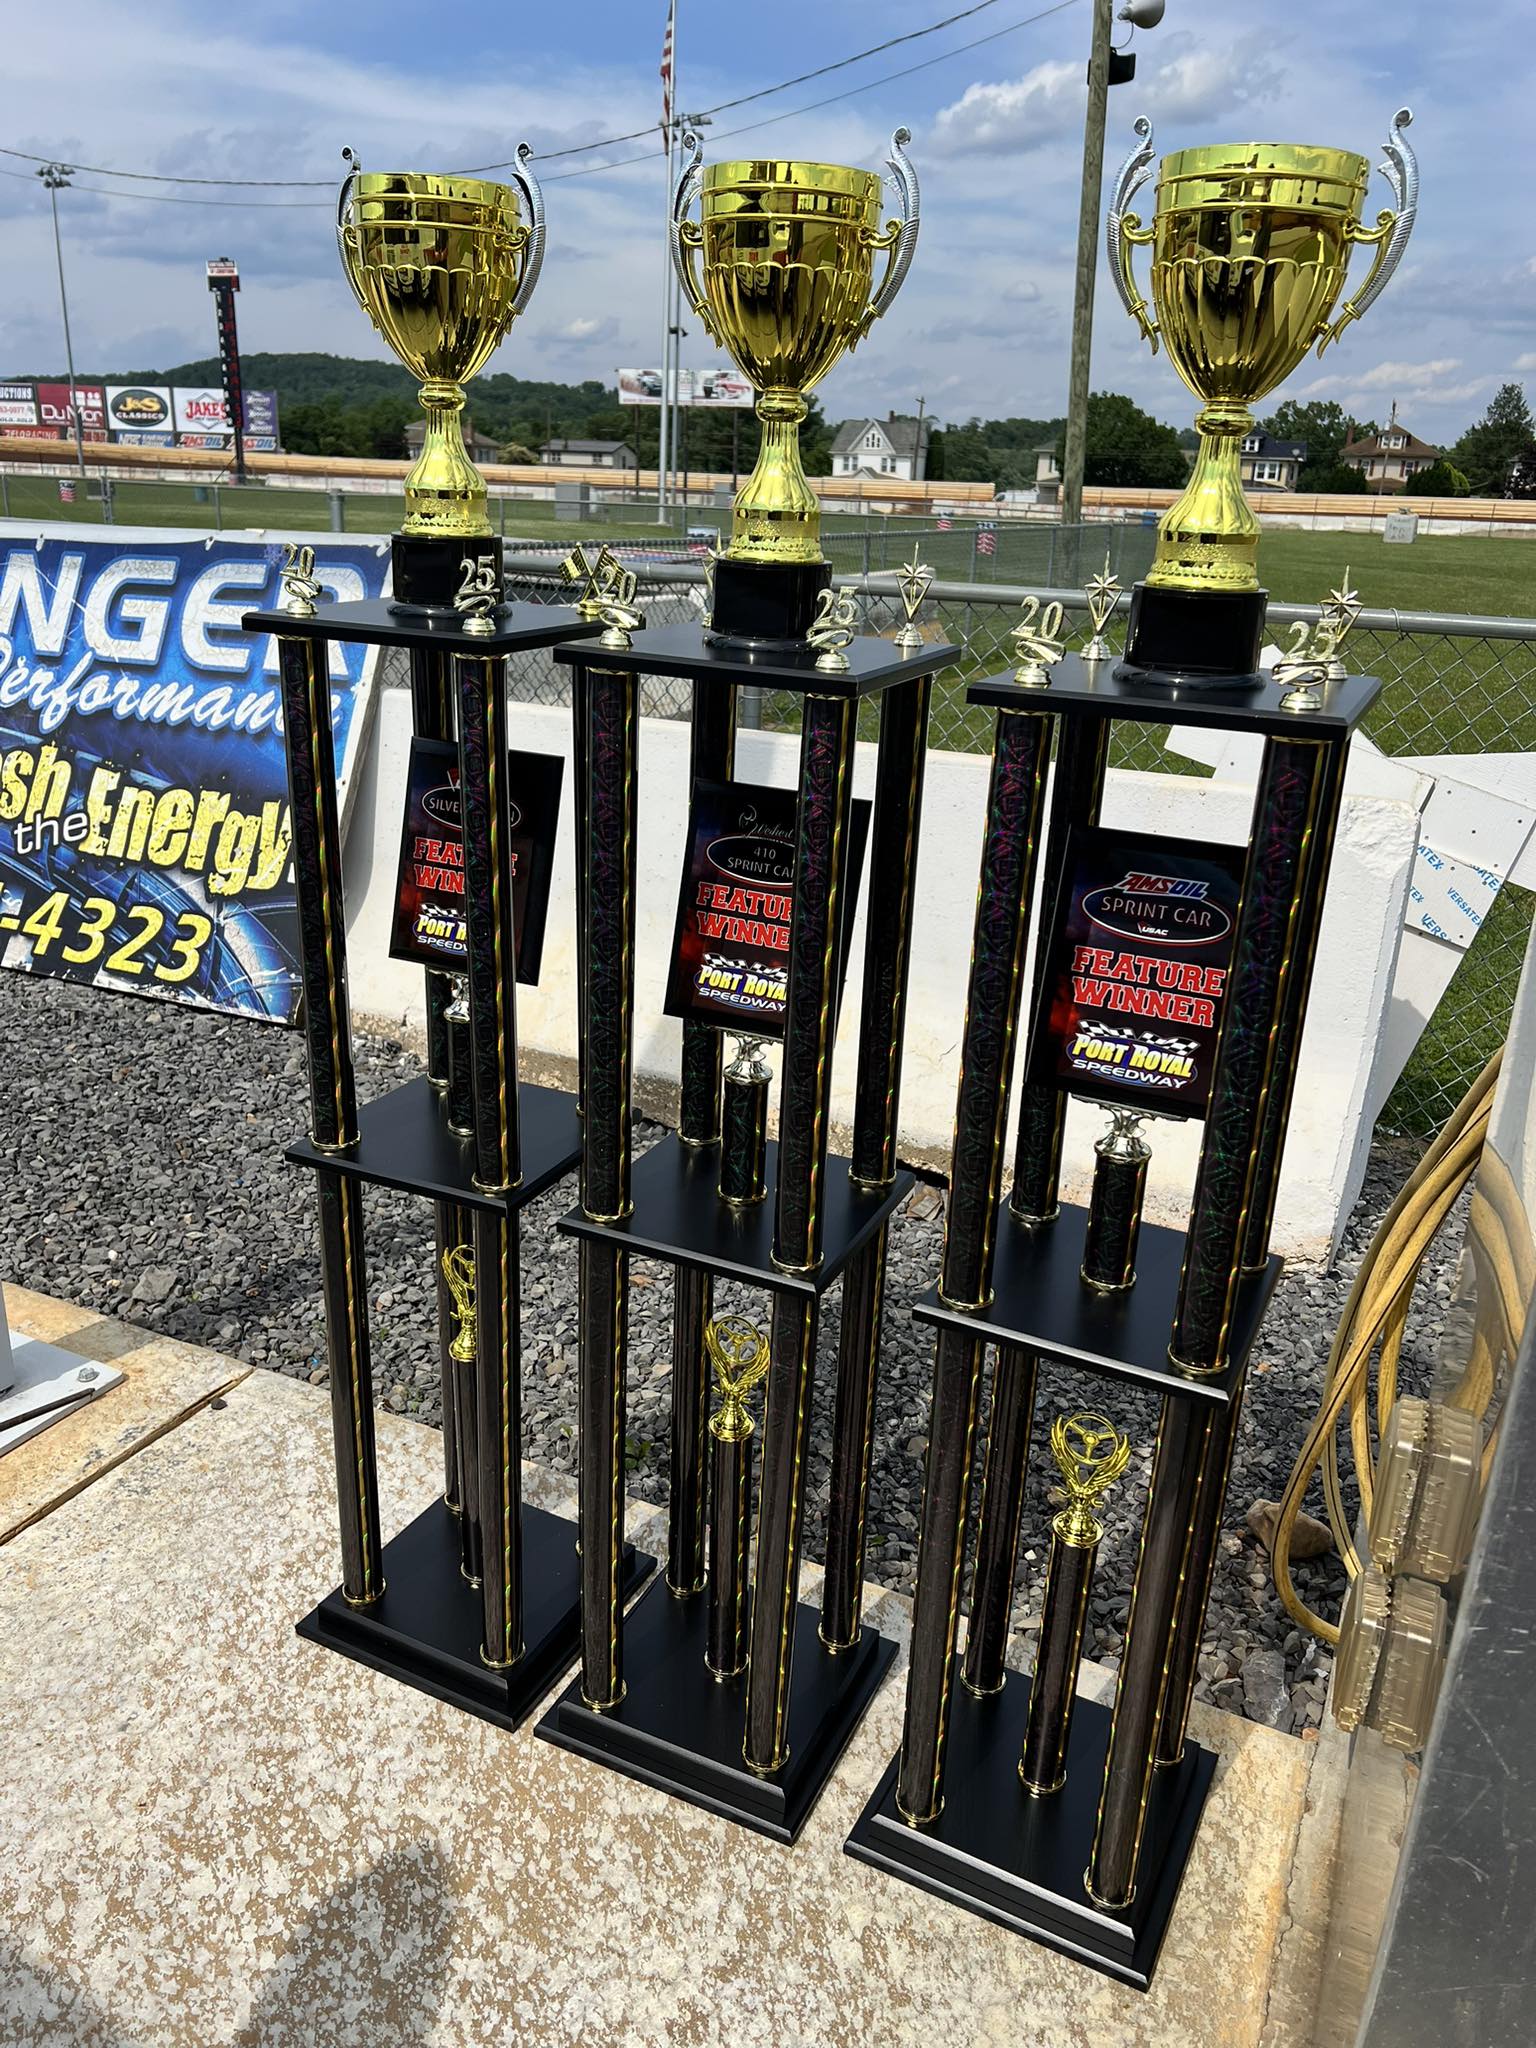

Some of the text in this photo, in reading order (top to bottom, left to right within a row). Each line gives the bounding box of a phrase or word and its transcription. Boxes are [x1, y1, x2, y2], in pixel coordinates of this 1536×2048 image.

[116, 411, 165, 420] CLASSICS
[177, 434, 224, 448] AMSOIL
[0, 636, 341, 732] erformane
[429, 797, 462, 814] SILVE
[14, 812, 88, 855] the
[79, 766, 292, 896] Energy
[728, 856, 794, 878] SPRINT CA
[754, 846, 776, 859] 410
[413, 864, 466, 895] WIN
[1113, 871, 1210, 899] AMSOIL
[696, 881, 792, 921] FEATU
[1101, 896, 1213, 927] SPRINT CAR
[416, 914, 455, 938] PORT
[696, 910, 791, 951] WINNE
[417, 935, 467, 952] SPEED
[699, 964, 788, 1001] PORT ROYA
[1071, 945, 1227, 996] FEATURE
[698, 987, 786, 1012] SPEEDWAY
[1072, 976, 1215, 1028] WINNER
[1071, 1032, 1195, 1077] PORT ROYAL
[1072, 1058, 1188, 1089] SPEEDWAY
